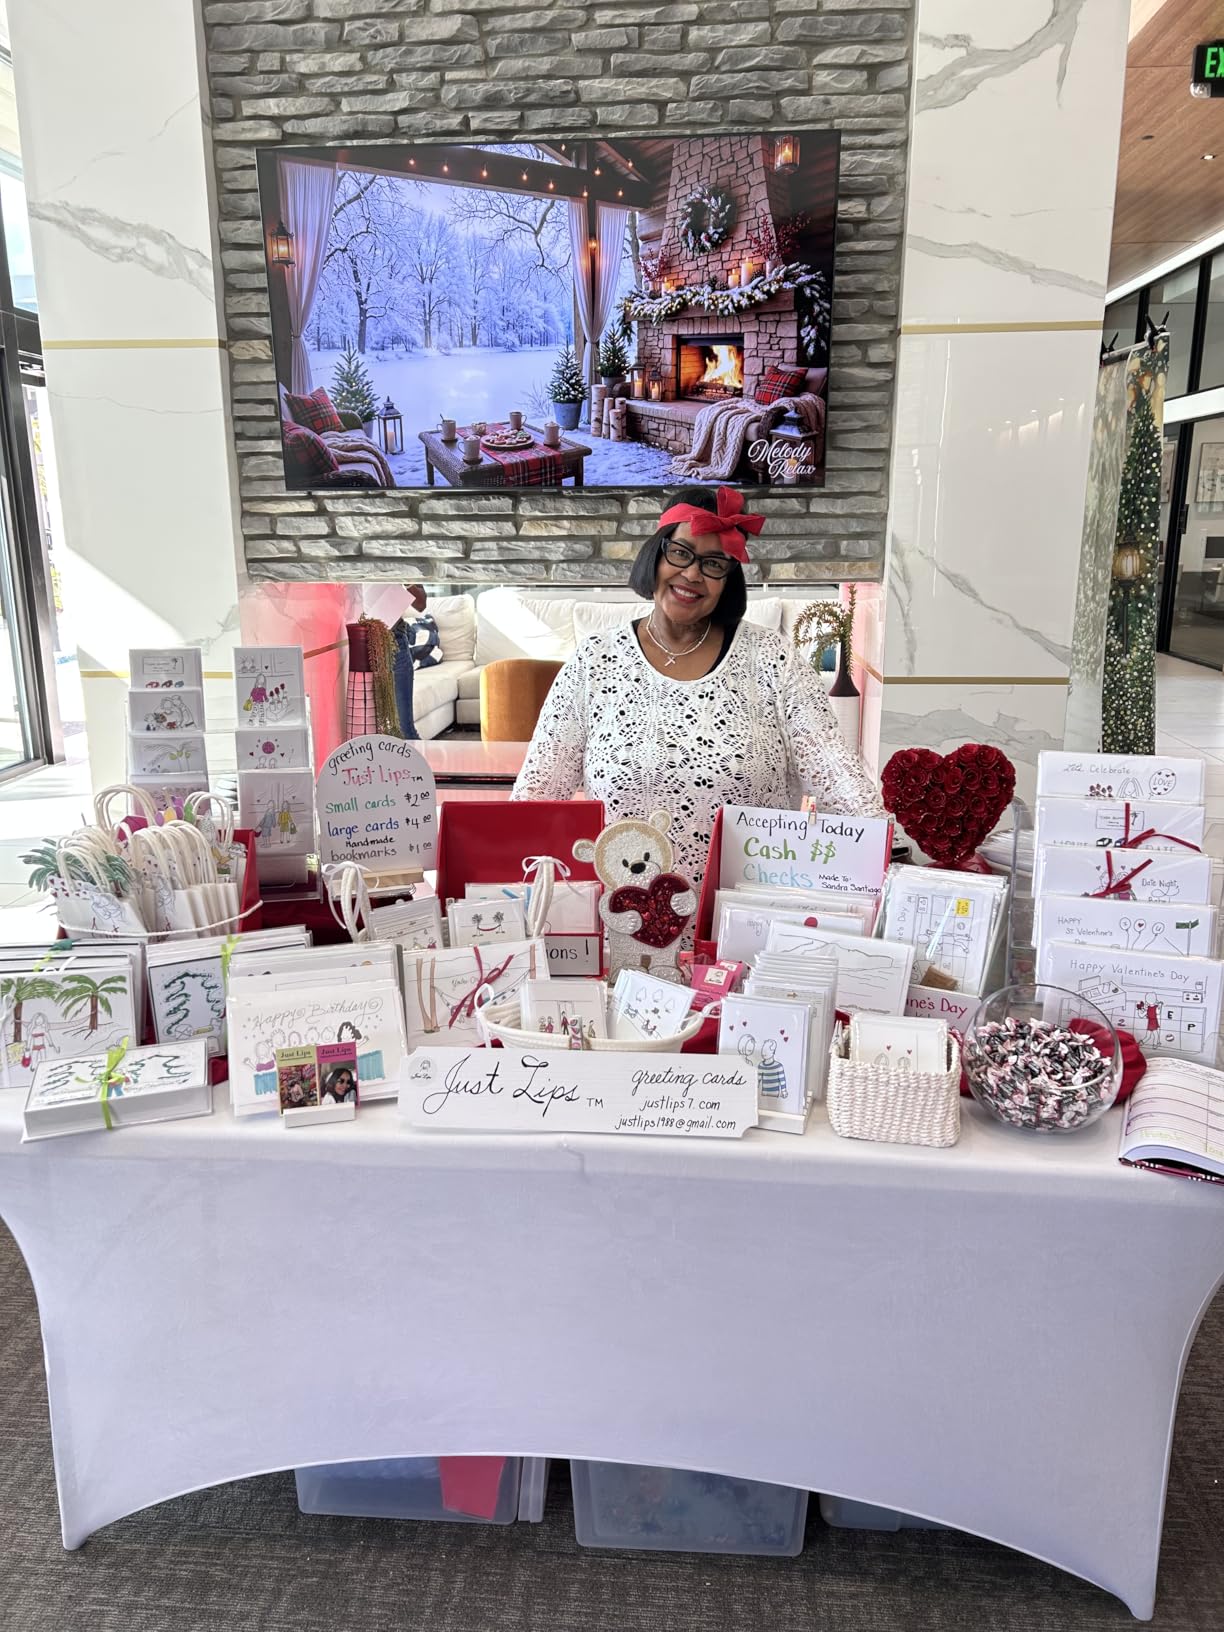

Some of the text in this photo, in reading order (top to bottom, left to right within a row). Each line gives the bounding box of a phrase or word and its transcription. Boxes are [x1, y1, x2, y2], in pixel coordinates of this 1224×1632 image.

[748, 439, 811, 466] Melody
[768, 458, 816, 478] Relax
[328, 741, 411, 776] greeting cards
[341, 766, 375, 786] Just
[378, 764, 411, 786] Lips
[1090, 764, 1131, 774] Celebrate
[1153, 777, 1174, 787] LOVE
[325, 797, 359, 813] small
[365, 794, 397, 809] cards
[327, 821, 359, 840] large
[365, 817, 400, 833] cards
[736, 811, 865, 843] Accepting Today
[330, 847, 397, 861] bookmarks
[743, 837, 837, 864] Cash $$
[743, 863, 814, 888] Checks
[818, 874, 840, 882] Made
[1142, 878, 1157, 887] Date
[821, 882, 882, 897] Sandra Santiago
[1057, 916, 1082, 925] HAPPY
[1076, 927, 1113, 936] Valentine's
[1070, 960, 1190, 983] Happy Valentine's Day
[251, 996, 384, 1031] Happy Birthday
[940, 998, 968, 1019] Day
[1167, 1011, 1174, 1019] E
[1187, 1023, 1196, 1031] P
[296, 1049, 311, 1059] Lips
[321, 1047, 335, 1055] Just
[422, 1054, 503, 1115] Just
[512, 1055, 581, 1117] Lips
[631, 1065, 747, 1097] greeting cards
